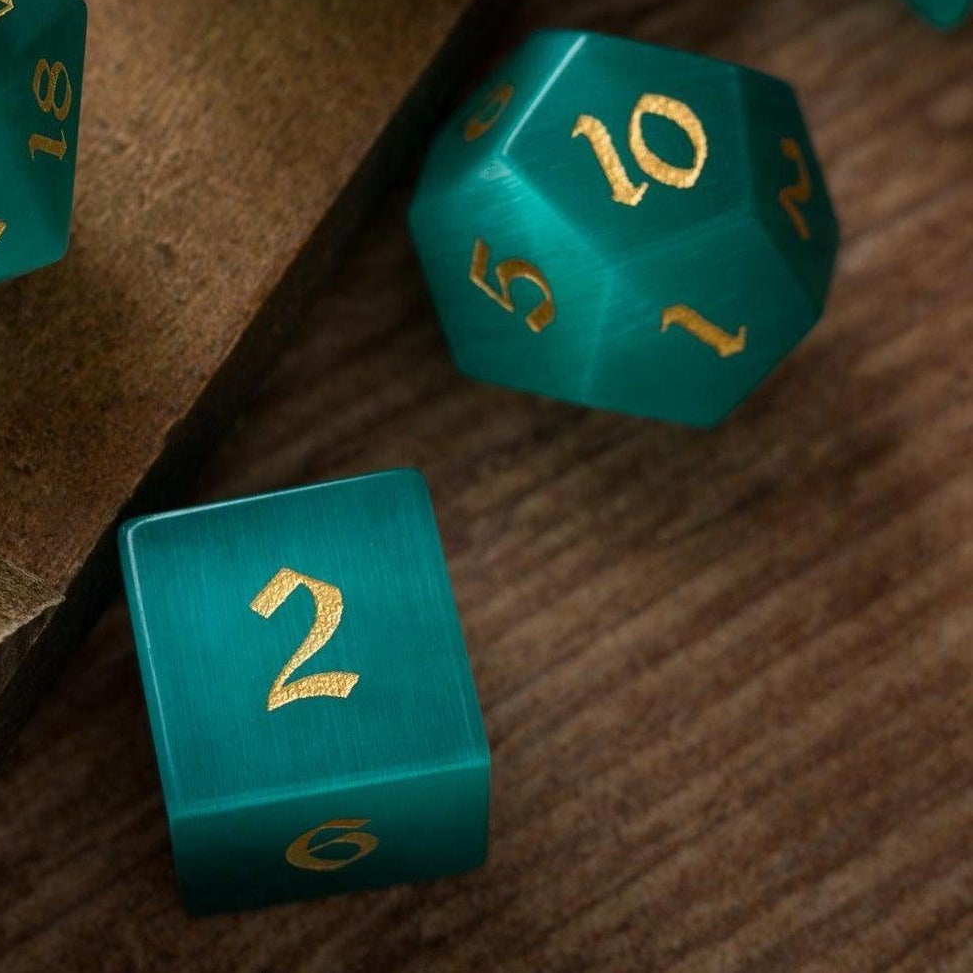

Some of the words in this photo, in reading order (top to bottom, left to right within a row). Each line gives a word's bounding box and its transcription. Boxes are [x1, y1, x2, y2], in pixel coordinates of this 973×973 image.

[29, 58, 72, 161] 18
[572, 93, 708, 206] 10
[778, 138, 811, 240] 2
[469, 238, 556, 334] 5
[661, 304, 747, 357] 1
[249, 567, 361, 712] 2
[285, 818, 379, 872] 6
